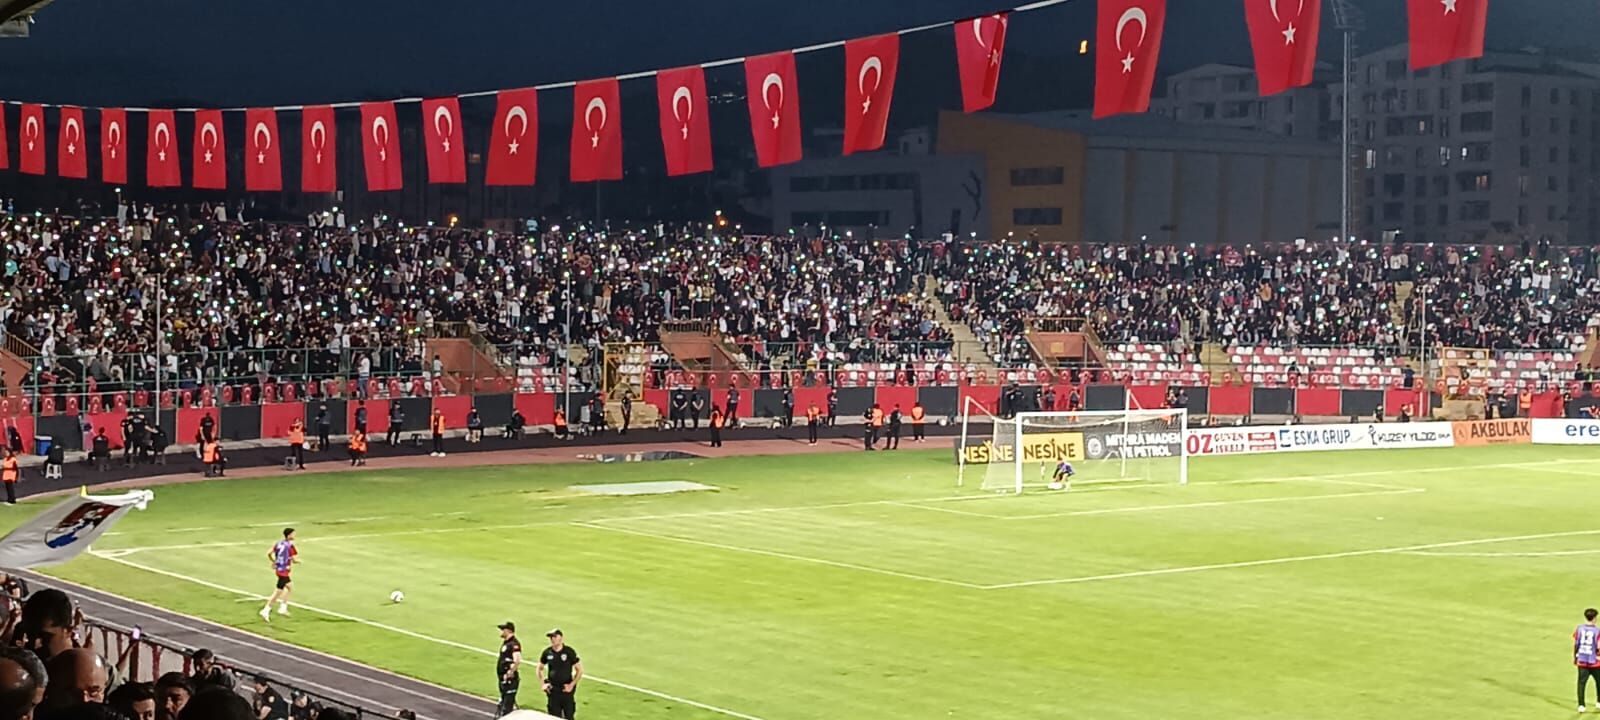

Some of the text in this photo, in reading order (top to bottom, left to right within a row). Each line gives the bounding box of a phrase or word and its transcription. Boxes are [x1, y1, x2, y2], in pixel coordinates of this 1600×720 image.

[1294, 430, 1320, 446] ESKA
[1322, 429, 1351, 444] GRUP
[1470, 421, 1531, 438] AKBULAK
[1134, 444, 1172, 458] PETROL
[1186, 430, 1214, 455] ÖZ
